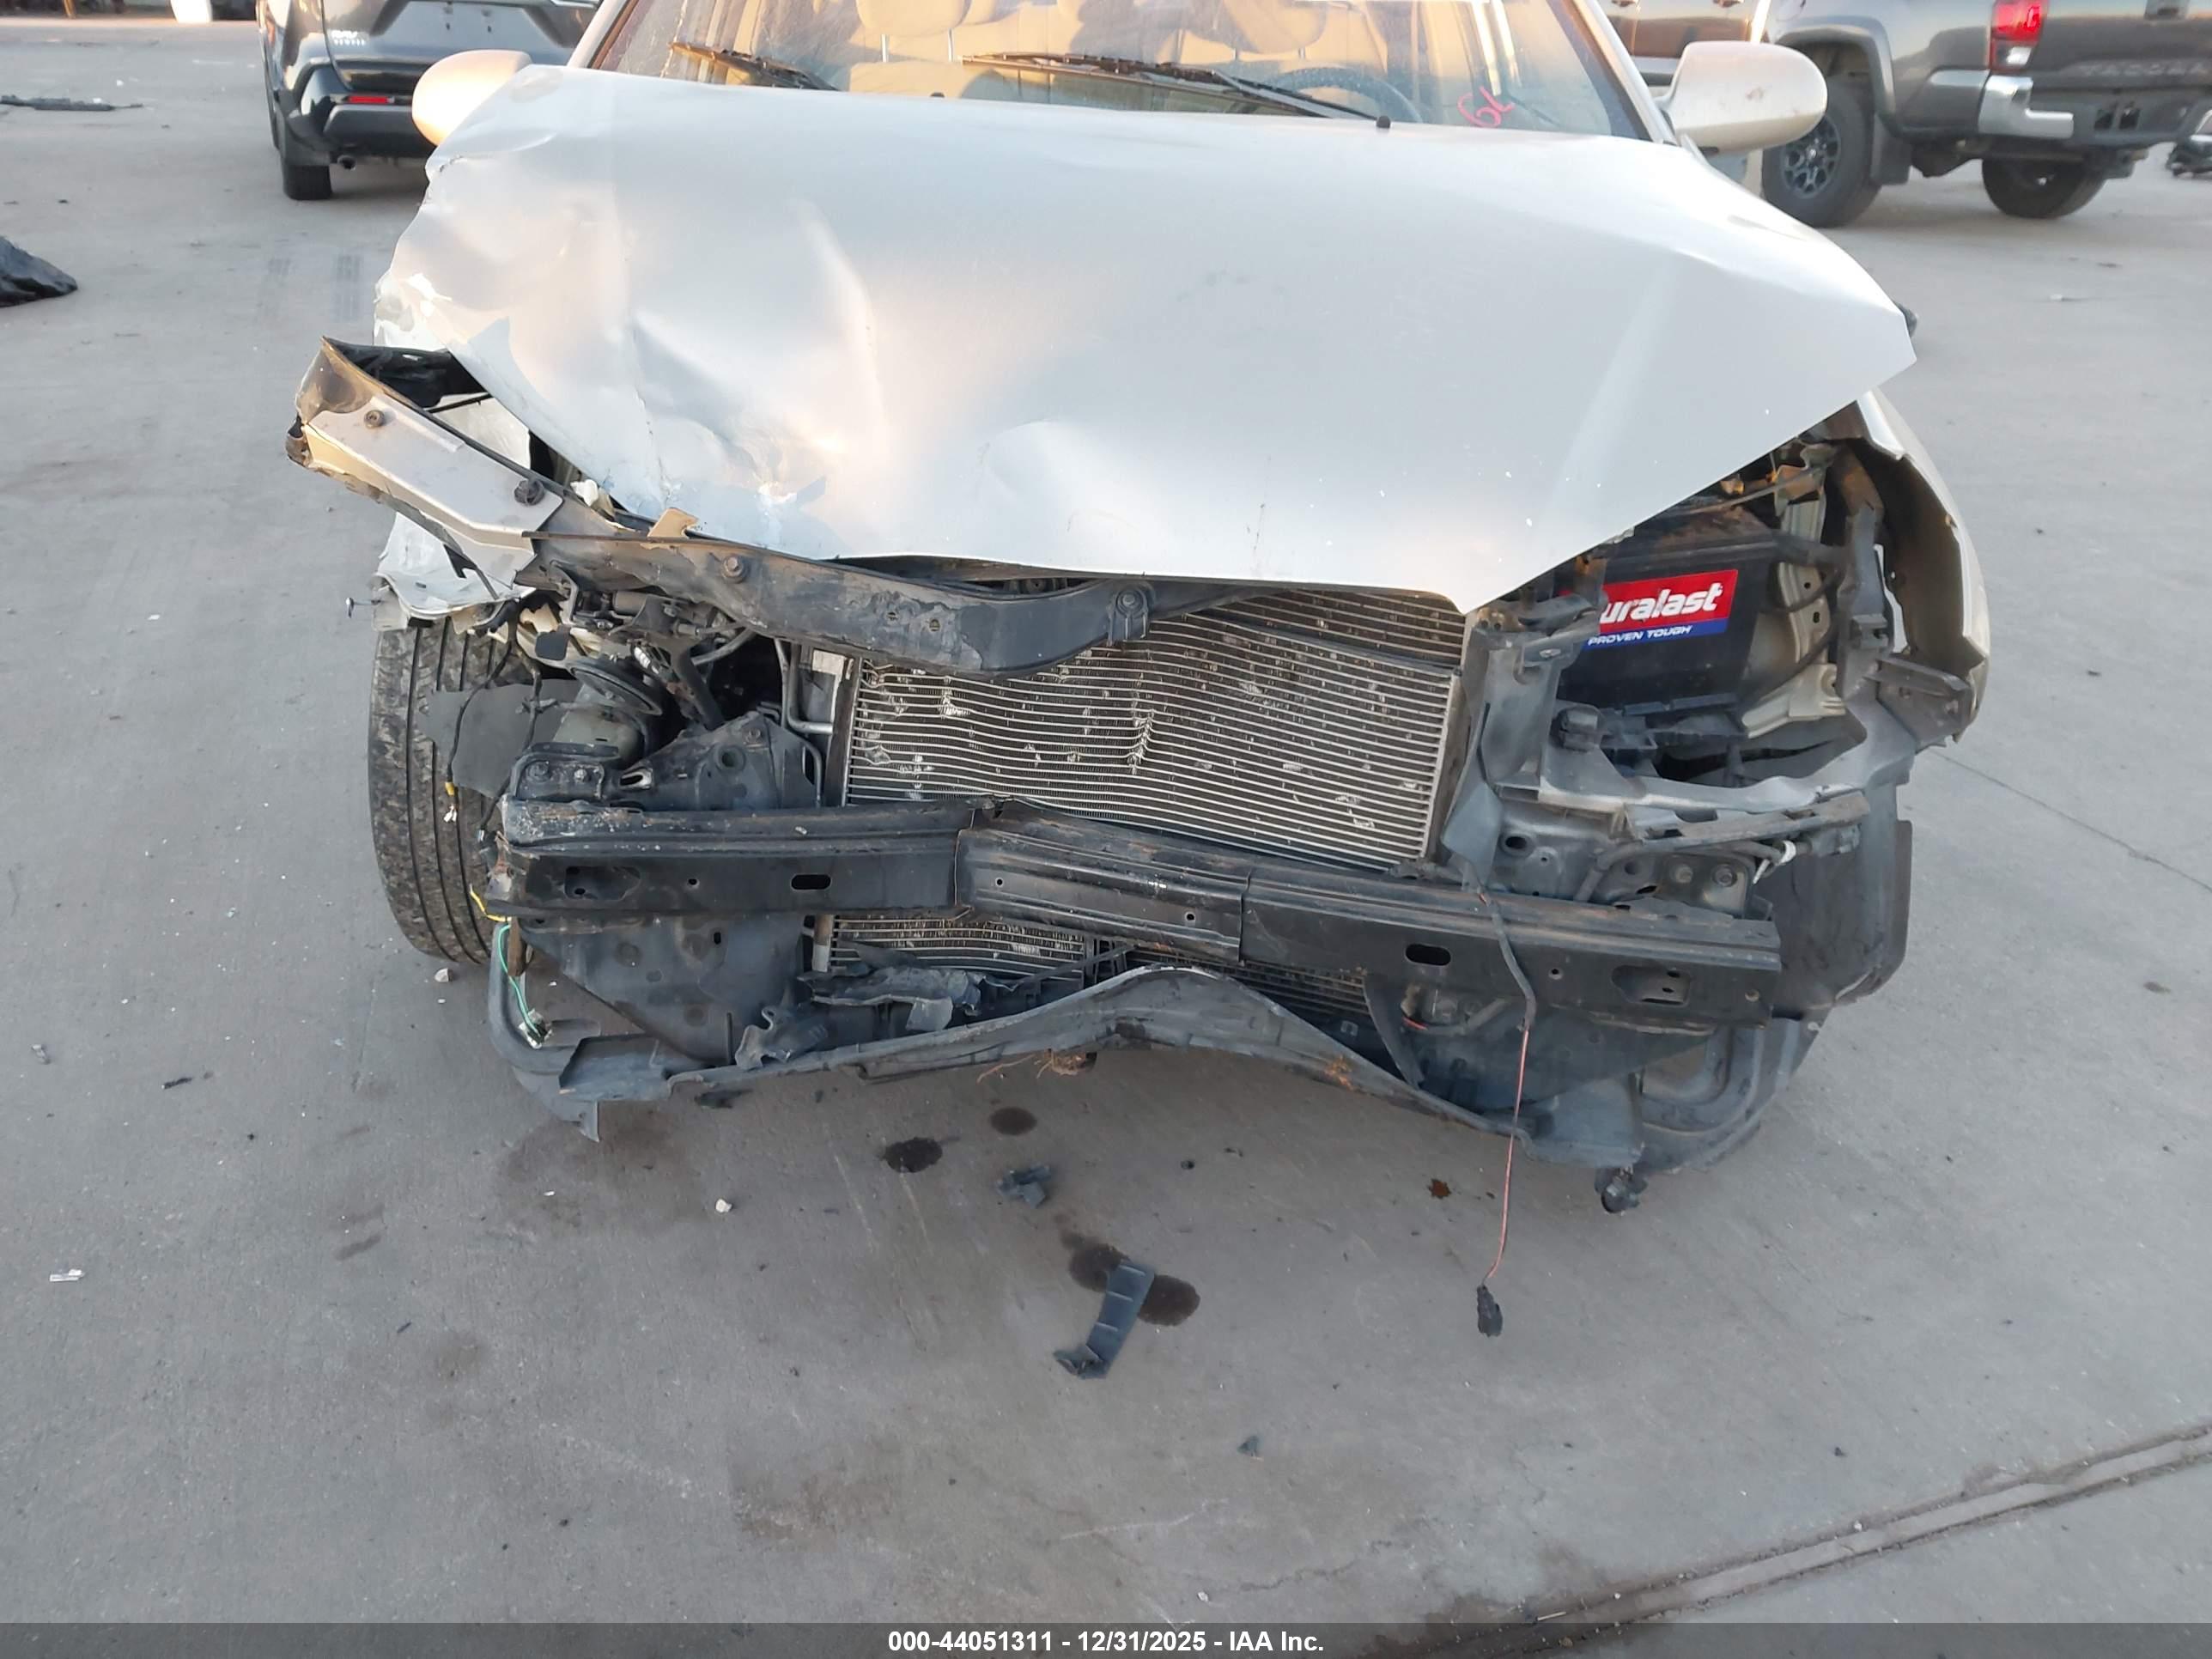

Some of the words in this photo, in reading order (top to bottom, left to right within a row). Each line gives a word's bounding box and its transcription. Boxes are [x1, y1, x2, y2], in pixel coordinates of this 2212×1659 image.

[1600, 582, 1724, 624] uralast
[1587, 630, 1644, 646] PROVEN
[1646, 625, 1693, 639] TOUGH
